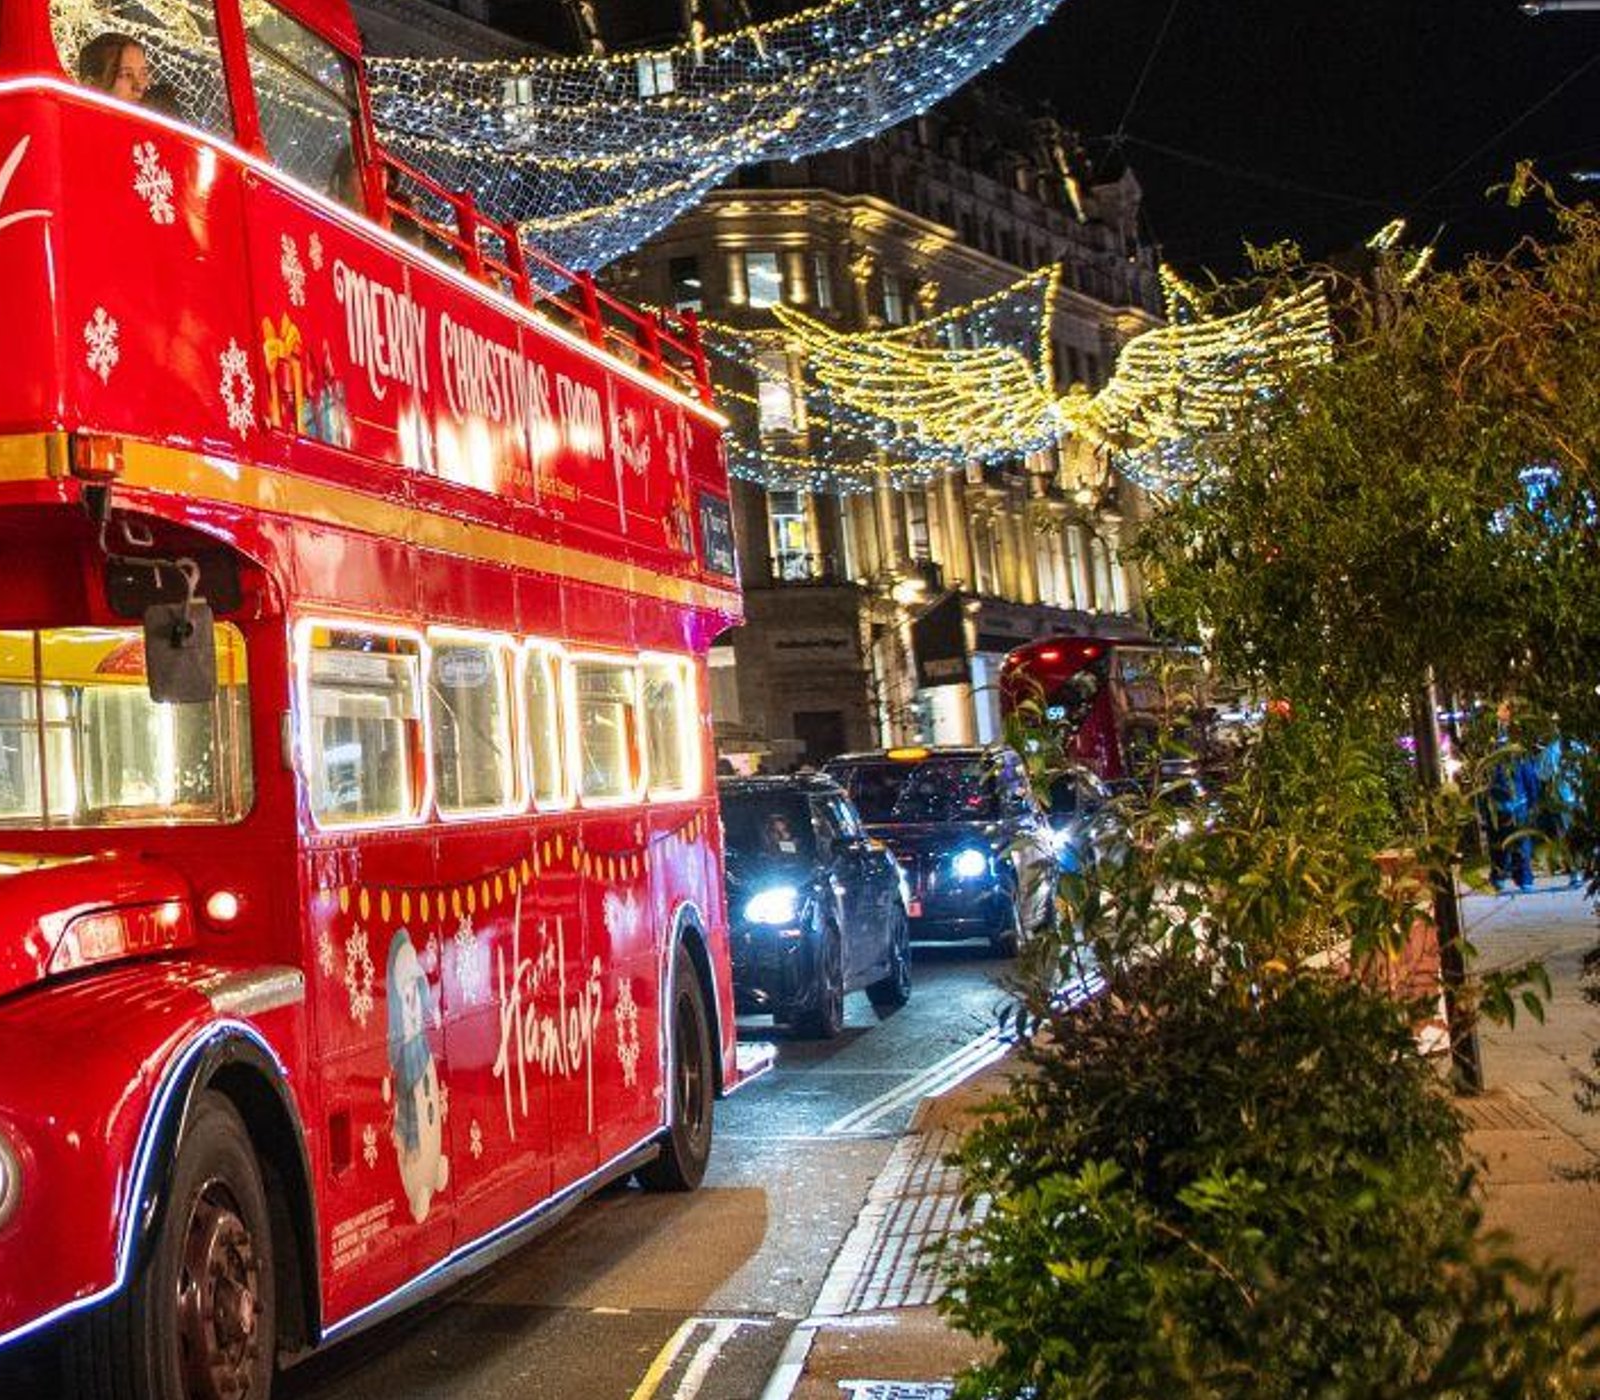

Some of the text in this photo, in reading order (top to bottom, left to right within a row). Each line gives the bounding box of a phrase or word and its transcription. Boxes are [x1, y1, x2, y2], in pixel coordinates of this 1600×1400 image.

[333, 258, 429, 401] MERRY
[439, 311, 552, 434] CHRISTMAS
[492, 882, 601, 1141] Hamleys
